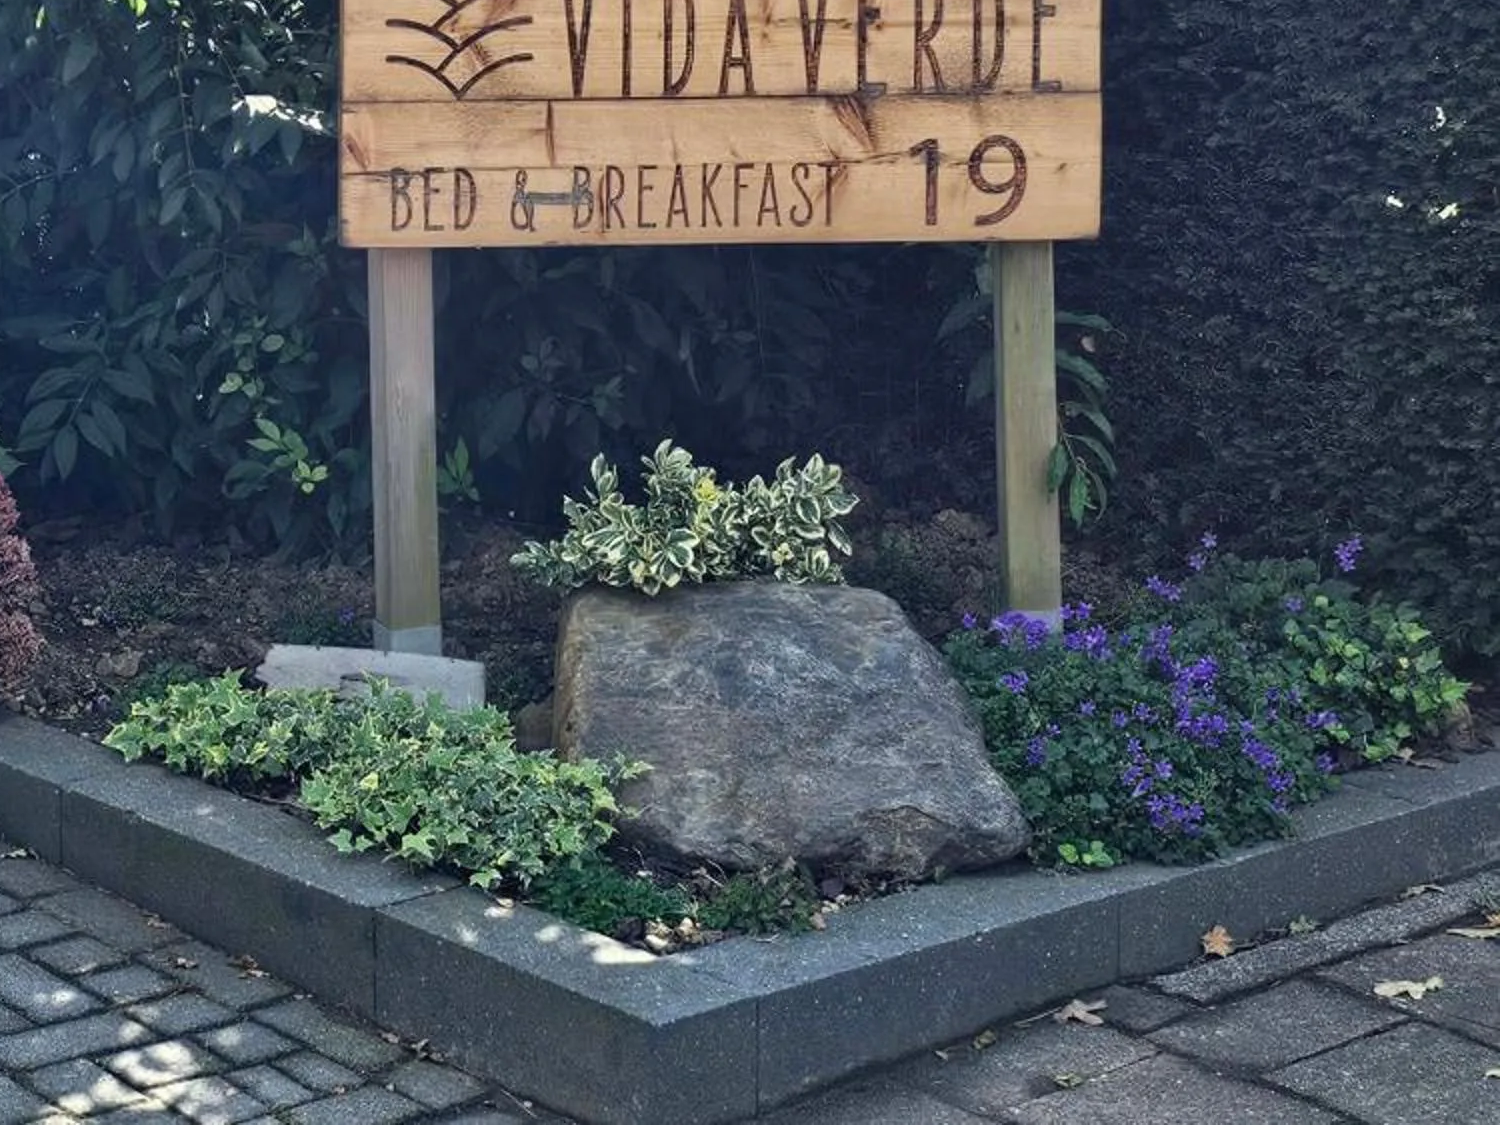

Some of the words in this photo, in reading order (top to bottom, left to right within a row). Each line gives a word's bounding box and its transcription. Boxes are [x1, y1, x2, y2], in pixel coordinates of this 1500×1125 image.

[389, 166, 478, 232] BED
[510, 169, 535, 232] &
[572, 161, 840, 231] BREAKFAST
[908, 134, 1029, 227] 19
